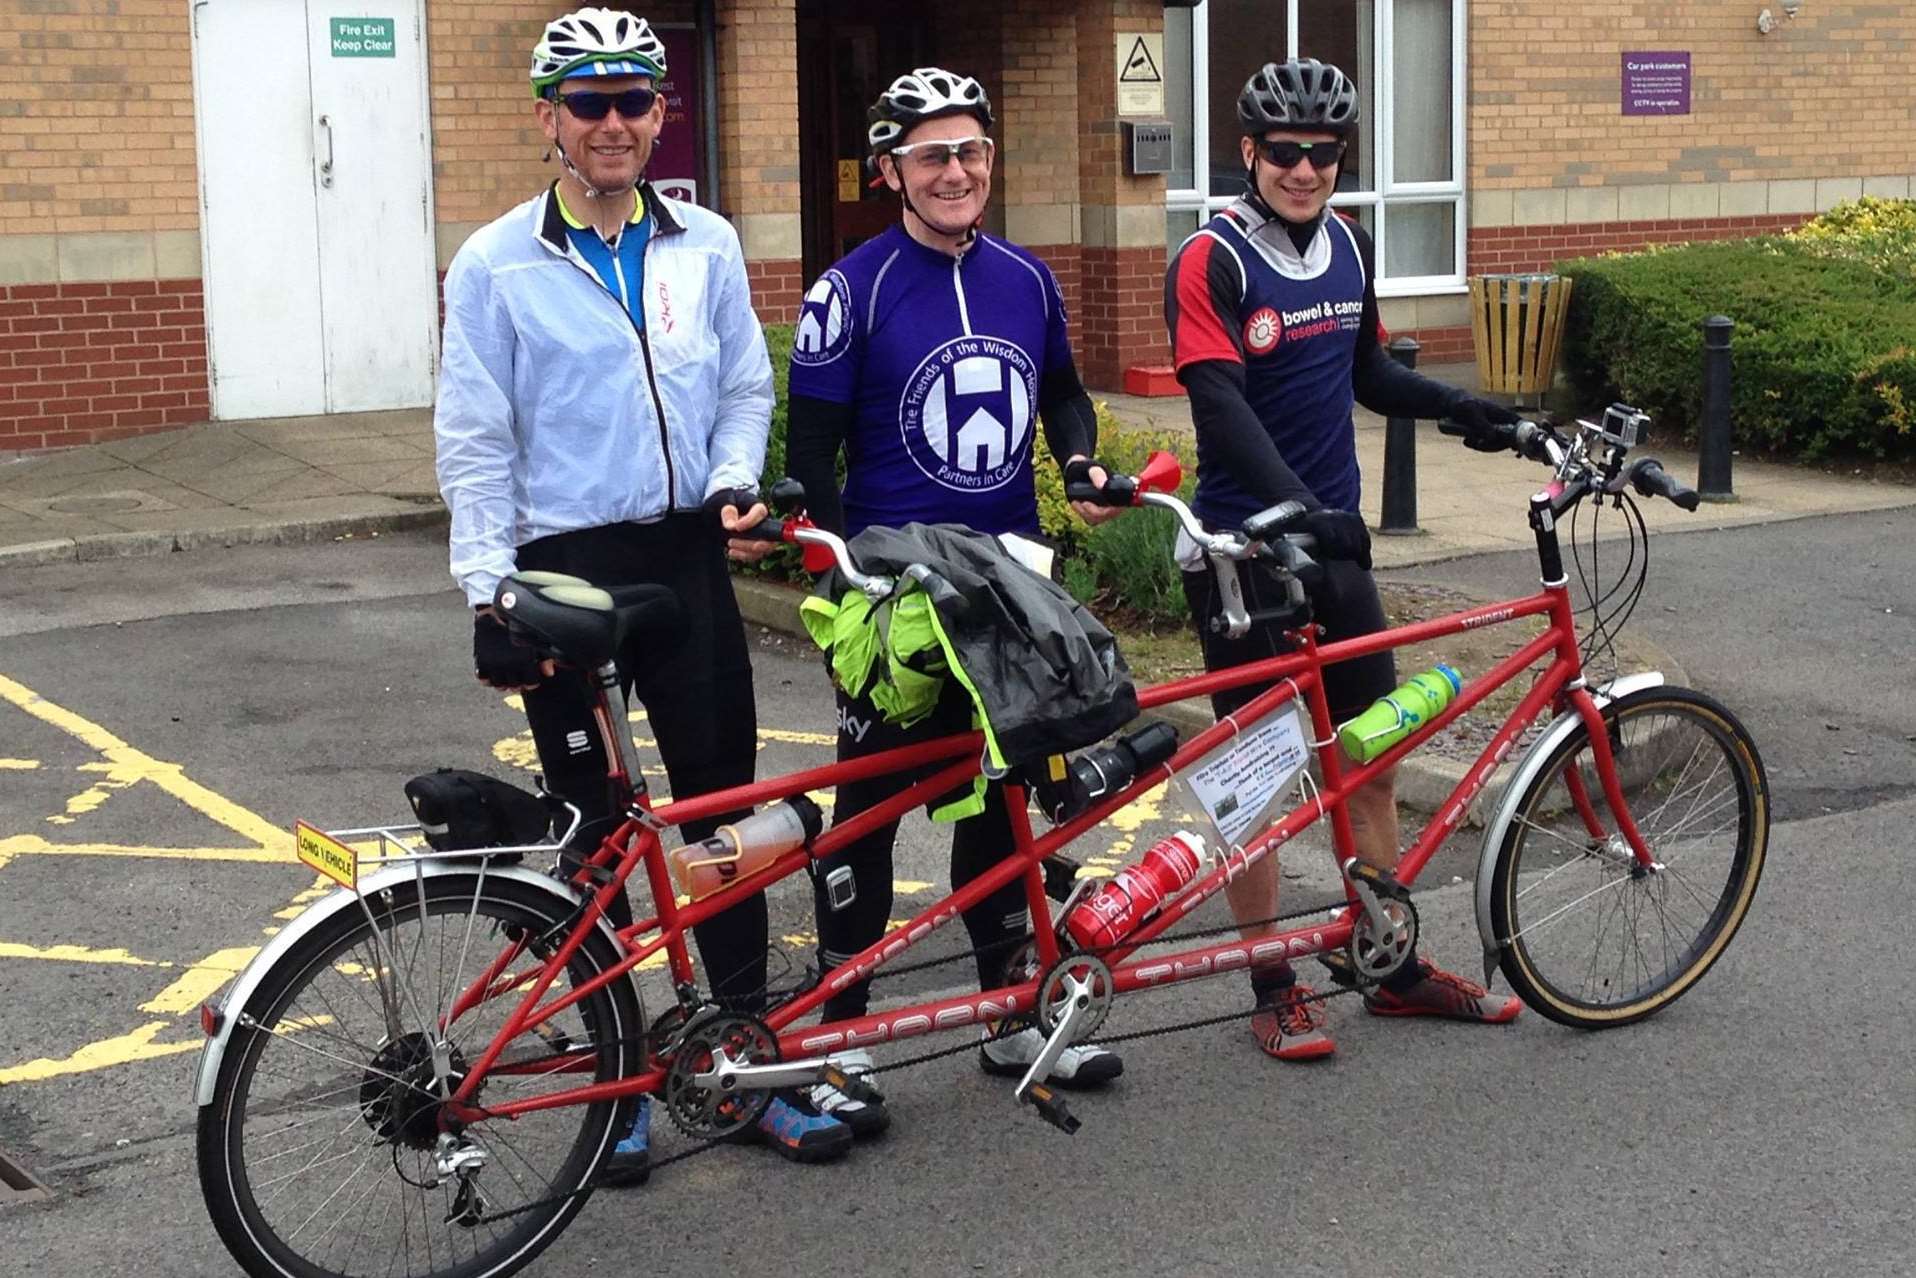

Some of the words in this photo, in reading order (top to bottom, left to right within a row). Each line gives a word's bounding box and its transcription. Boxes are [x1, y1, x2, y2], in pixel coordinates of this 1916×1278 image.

[339, 24, 361, 36] Fire
[363, 24, 385, 36] Exit
[333, 39, 361, 53] Keep
[363, 39, 393, 51] Clear
[1627, 61, 1640, 70] Car
[1640, 61, 1654, 72] park
[1655, 62, 1687, 70] customers
[1282, 303, 1322, 327] bowel
[1323, 301, 1334, 317] &
[1285, 319, 1337, 342] research
[941, 348, 954, 365] of
[956, 341, 979, 355] the
[982, 341, 1028, 371] Wisdom
[906, 363, 941, 406] Friends
[905, 408, 918, 432] The
[937, 464, 982, 487] Partners
[983, 474, 995, 486] in
[994, 461, 1015, 481] Care
[1466, 607, 1515, 629] TRIDENT
[836, 705, 872, 743] sky
[299, 835, 319, 857] LONG
[321, 847, 352, 876] VEHICLE
[801, 994, 1017, 1052] THORN
